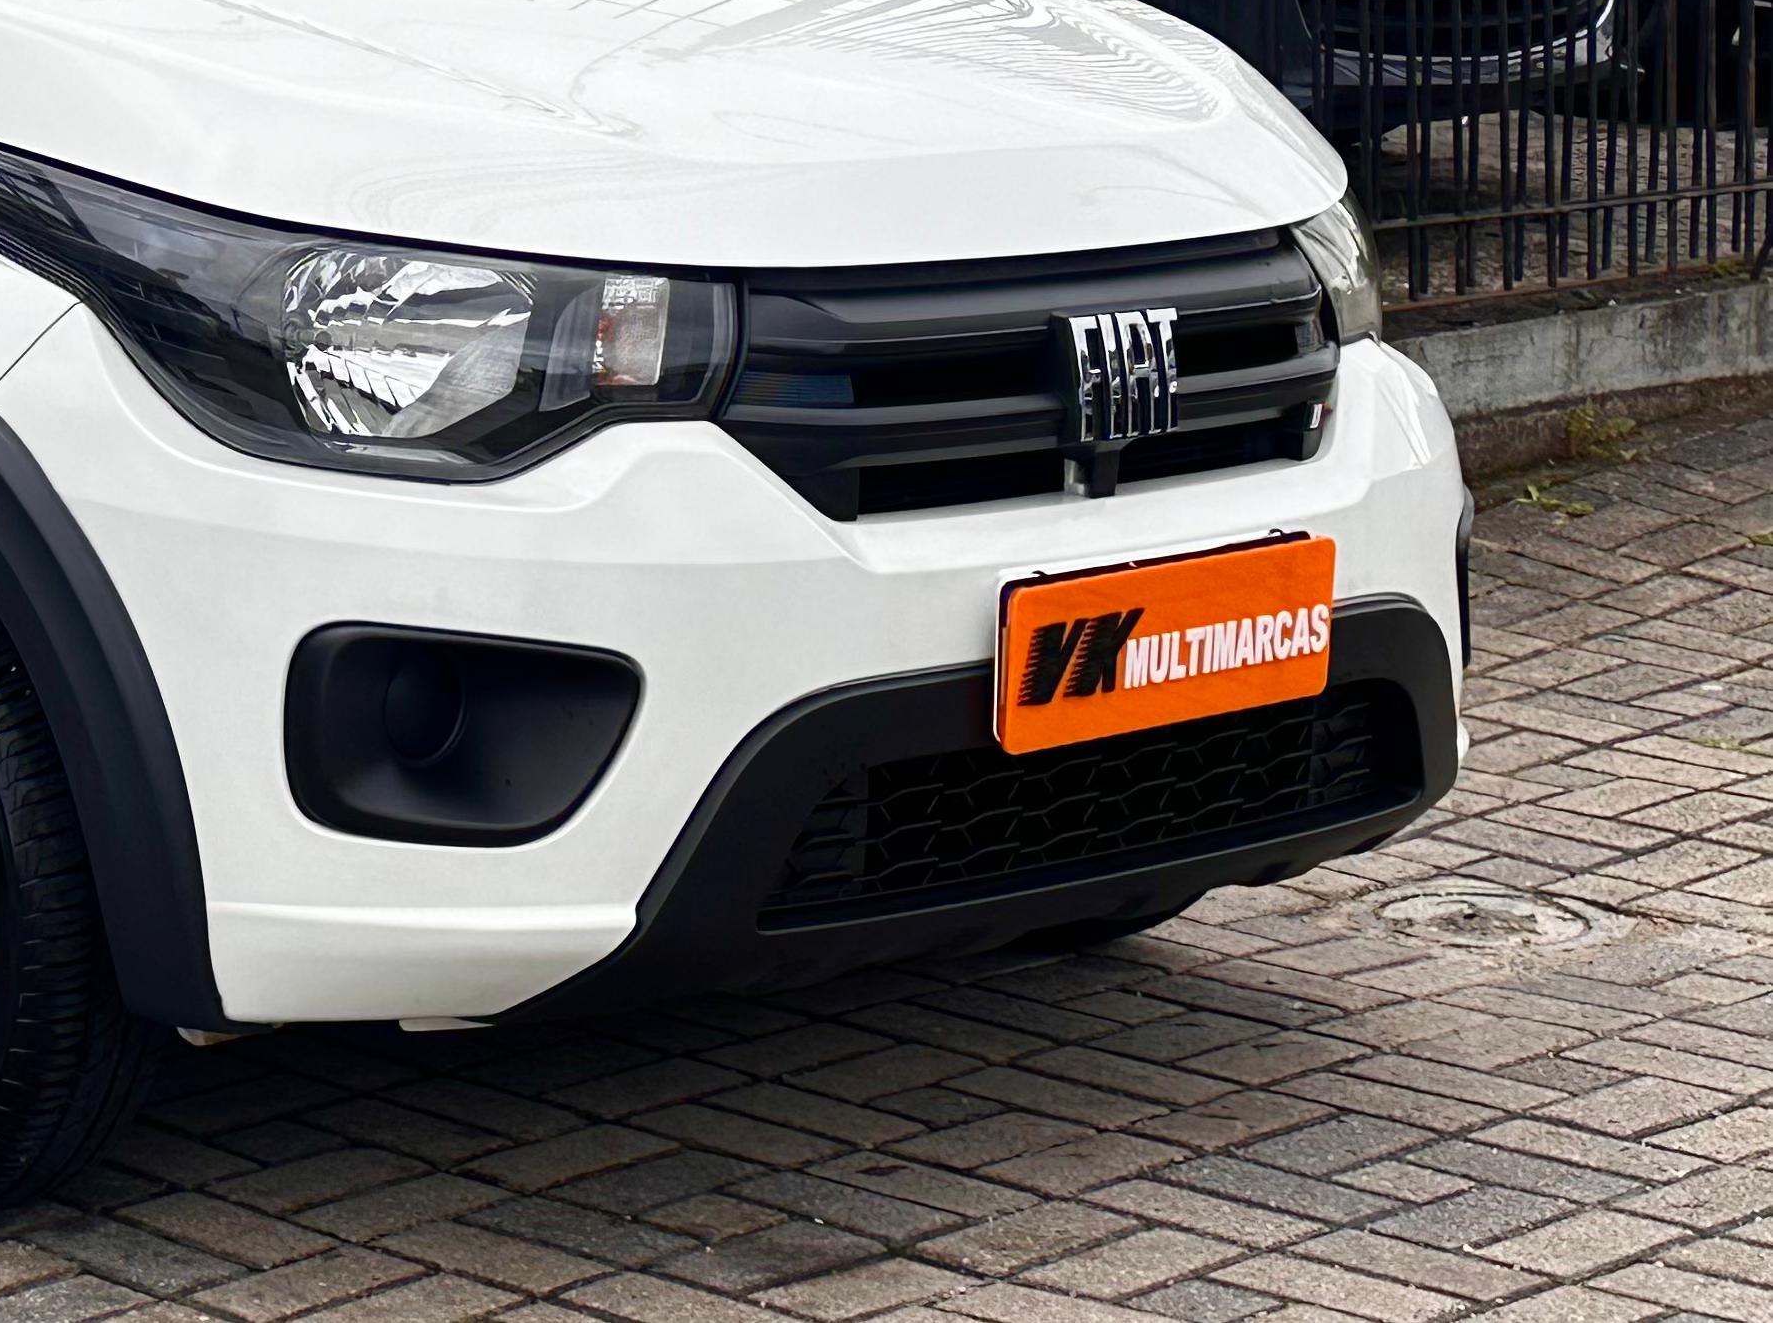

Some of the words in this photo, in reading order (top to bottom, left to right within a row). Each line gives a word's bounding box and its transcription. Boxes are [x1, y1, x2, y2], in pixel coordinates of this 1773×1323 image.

[1068, 307, 1179, 443] FIAT
[1017, 606, 1146, 707] VK
[1123, 603, 1330, 690] MULTIMARCAS
